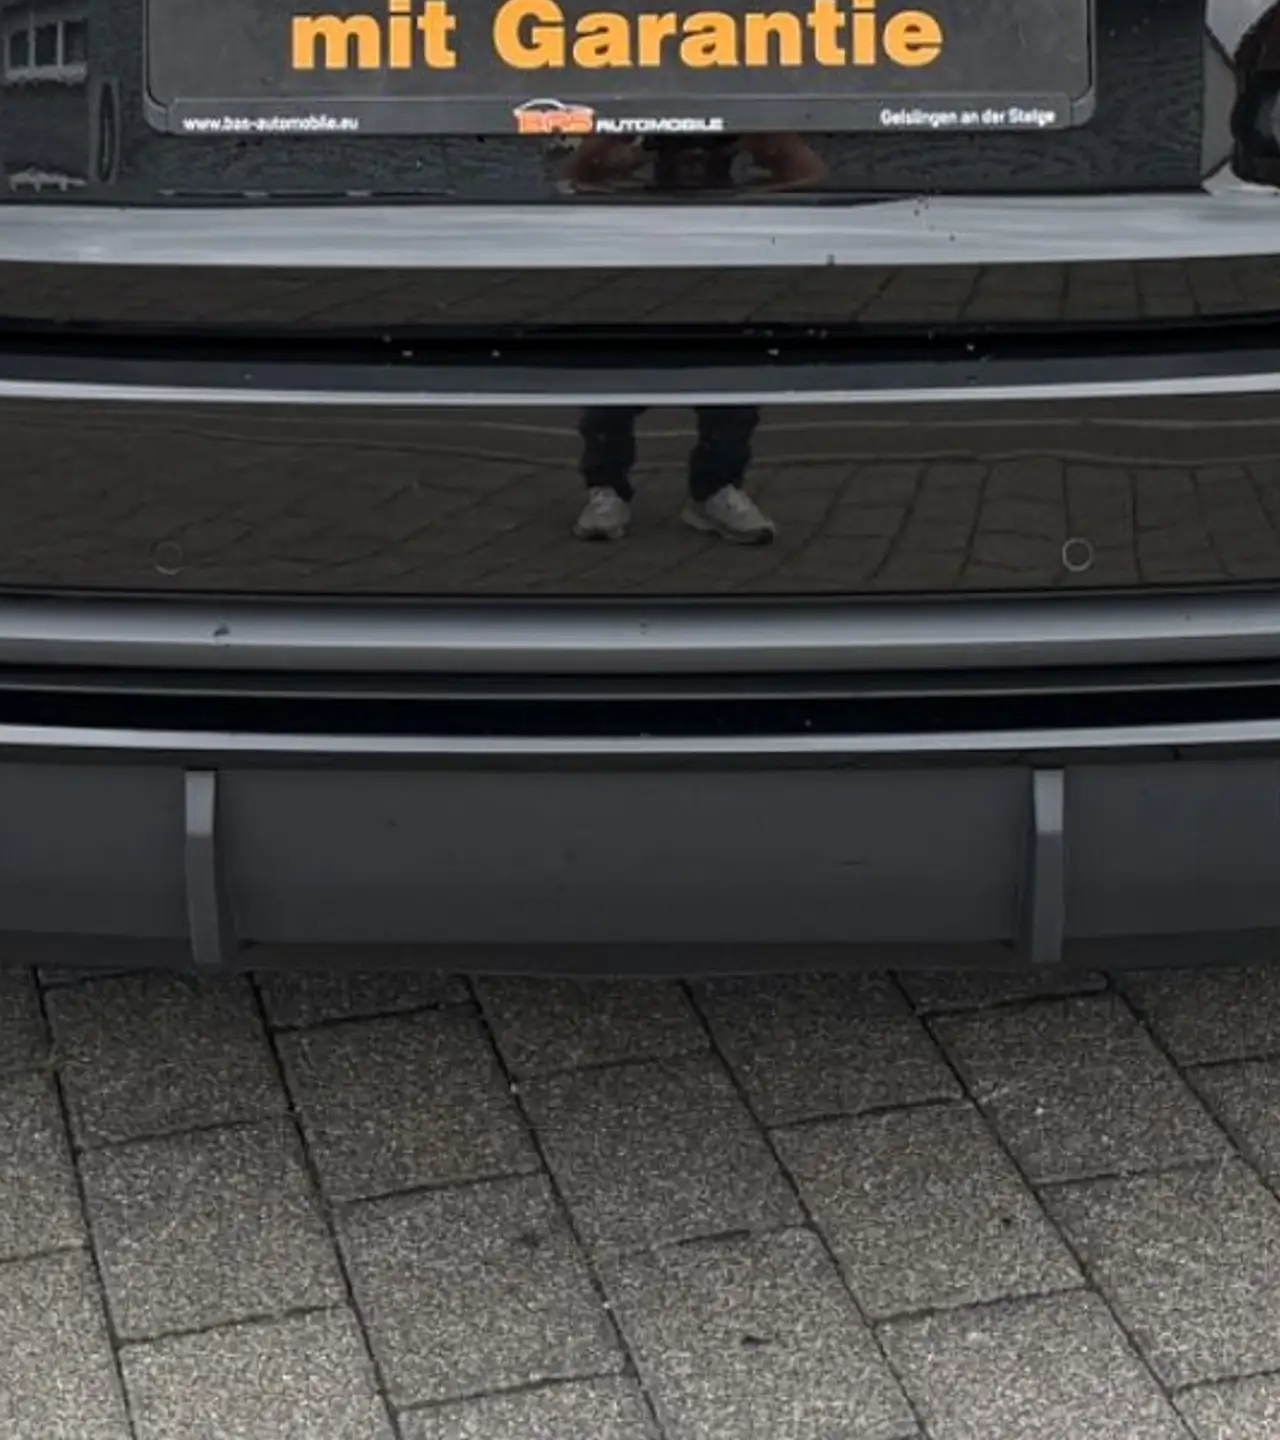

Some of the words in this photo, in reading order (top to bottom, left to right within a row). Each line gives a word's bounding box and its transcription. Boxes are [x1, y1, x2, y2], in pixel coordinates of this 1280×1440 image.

[596, 117, 725, 132] AUTOMOBILE
[960, 112, 980, 125] an
[982, 108, 1005, 124] der
